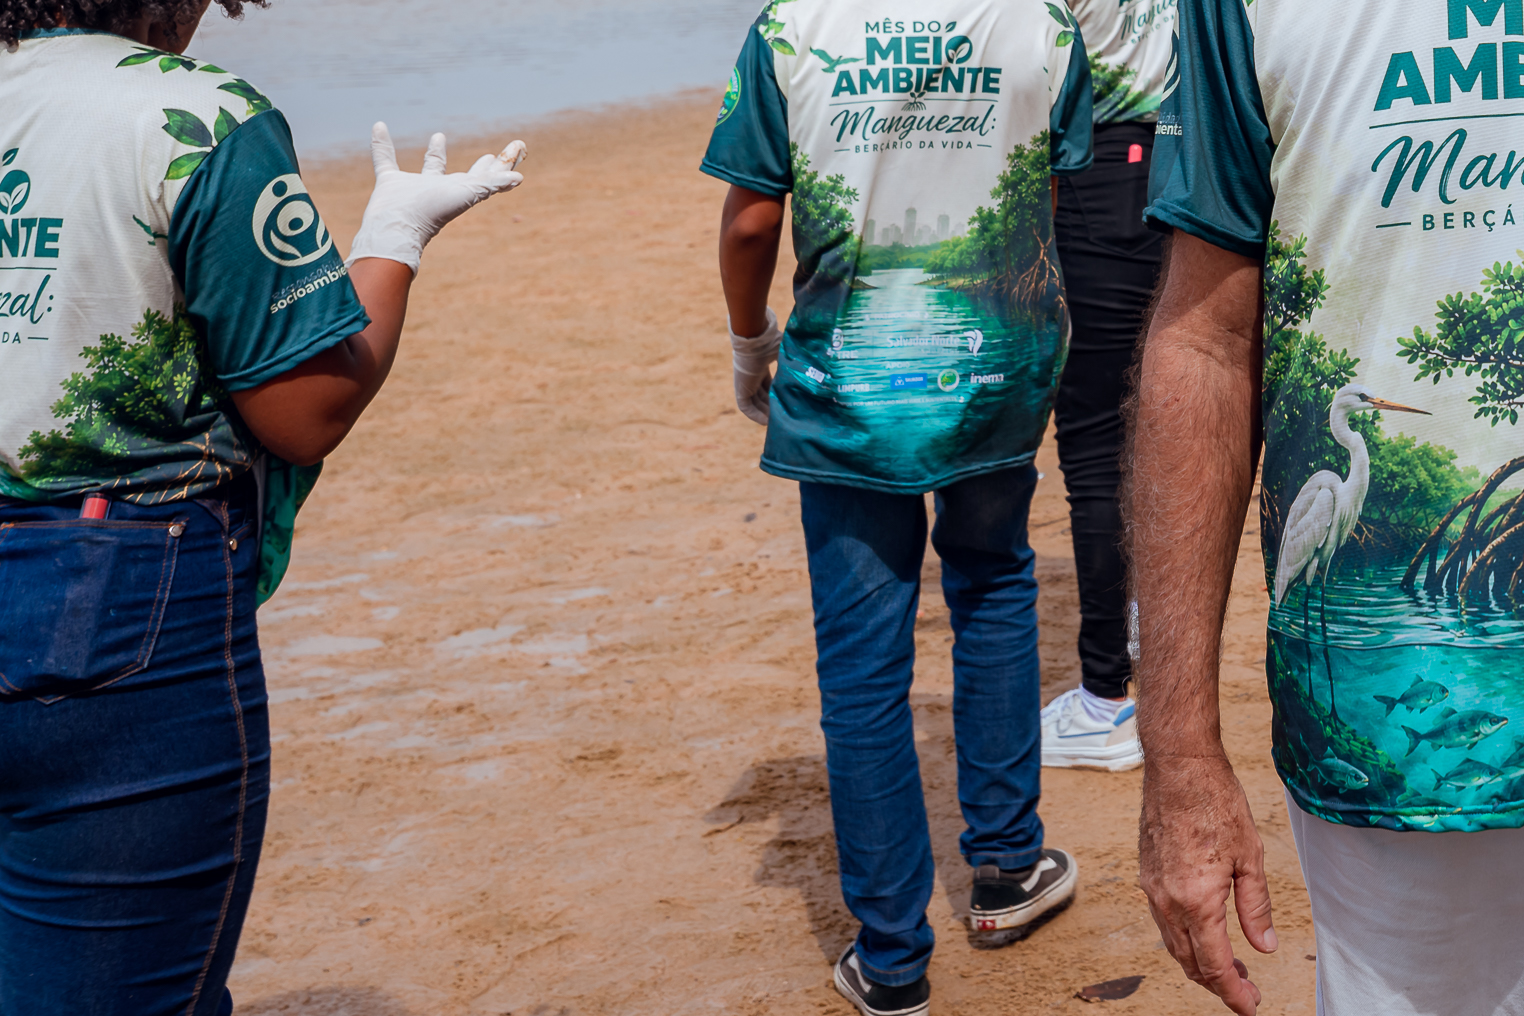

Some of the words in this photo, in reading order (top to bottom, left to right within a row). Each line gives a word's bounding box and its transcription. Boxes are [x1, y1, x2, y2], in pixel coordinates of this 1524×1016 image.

[865, 17, 905, 34] MÊS
[913, 20, 942, 33] DO
[865, 35, 973, 66] MEIO
[831, 66, 1003, 98] AMBIENTE
[830, 104, 997, 143] Manguezal:
[855, 139, 913, 153] BERÇÁRIO
[919, 140, 934, 149] DA
[942, 140, 973, 150] VIDA
[886, 335, 930, 348] Salvador
[931, 334, 960, 346] Norte
[970, 372, 1004, 384] inema
